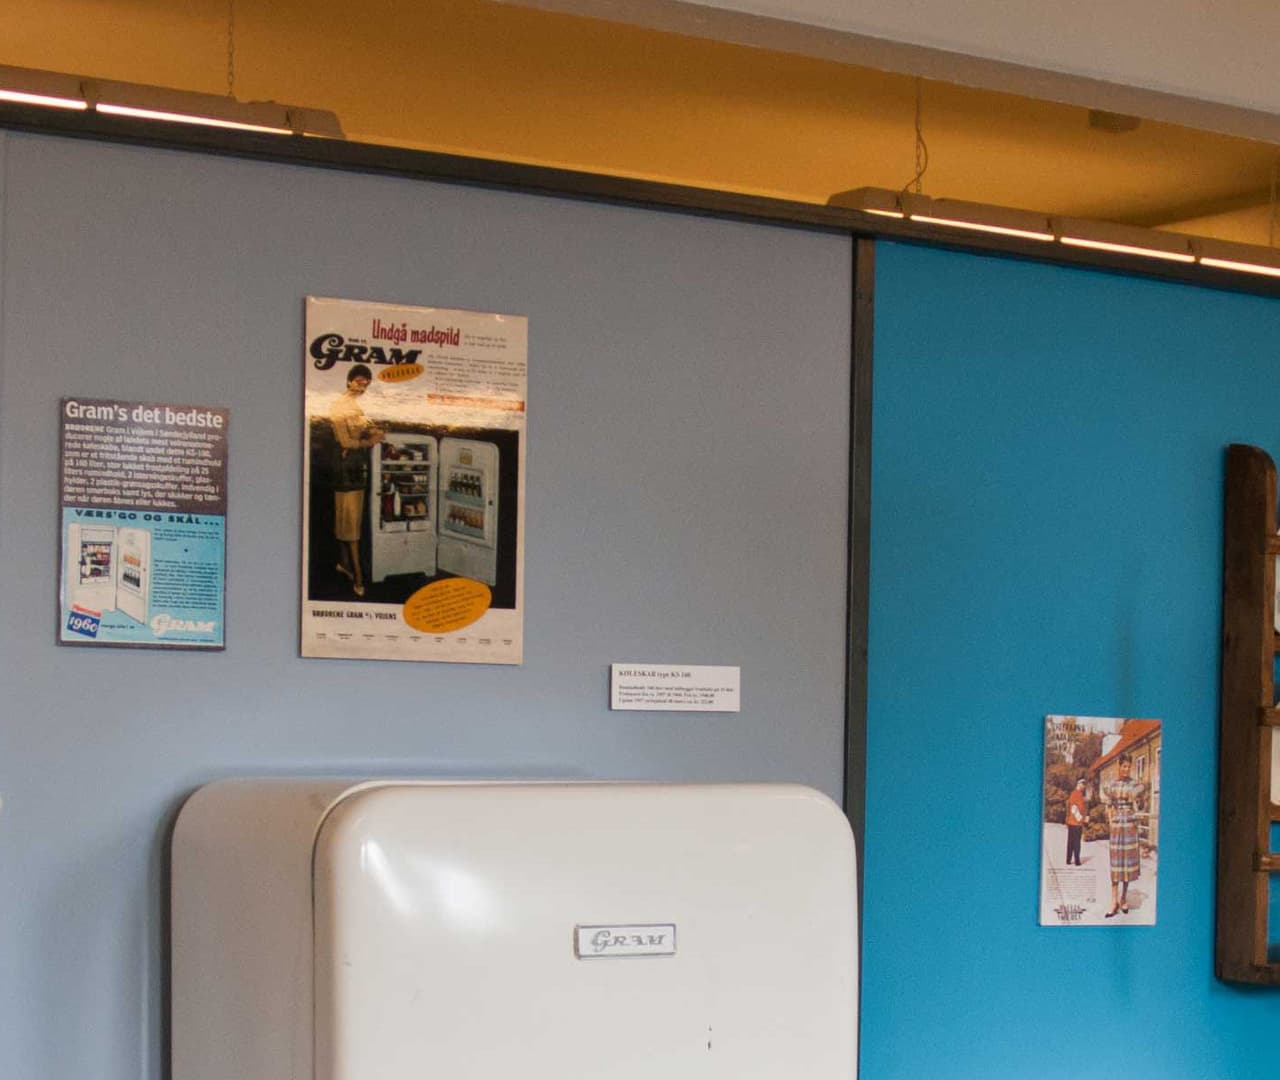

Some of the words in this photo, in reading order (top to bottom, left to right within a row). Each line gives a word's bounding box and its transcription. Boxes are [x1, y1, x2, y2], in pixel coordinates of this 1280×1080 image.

[372, 319, 407, 345] Undgå
[411, 327, 461, 348] madspild
[310, 333, 422, 371] GRAM
[66, 401, 129, 421] Gram's
[132, 405, 160, 424] det
[165, 407, 223, 428] bedste
[143, 513, 162, 522] OG
[70, 616, 98, 632] 1960
[591, 930, 666, 953] GRAM
